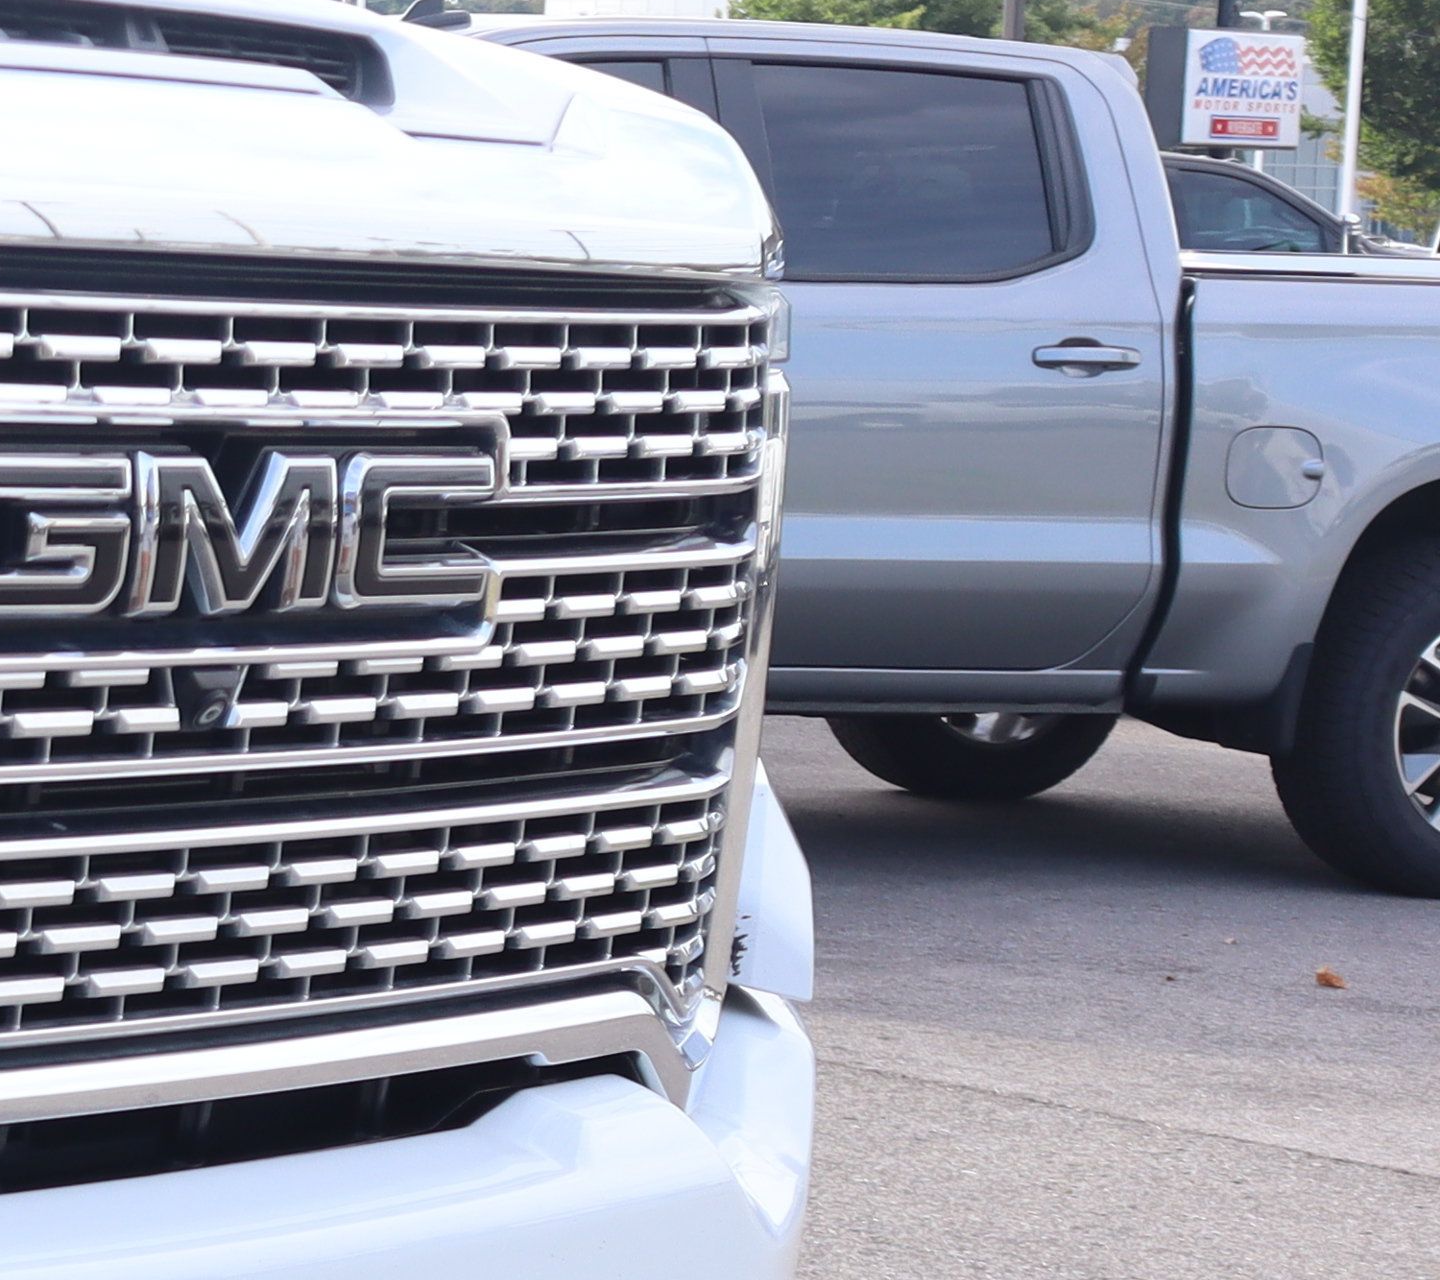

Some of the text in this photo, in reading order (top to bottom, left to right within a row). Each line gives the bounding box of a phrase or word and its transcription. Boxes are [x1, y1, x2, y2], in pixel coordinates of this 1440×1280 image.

[1195, 77, 1298, 100] AMERICA'S
[1193, 99, 1296, 113] MOTOR SPORTS
